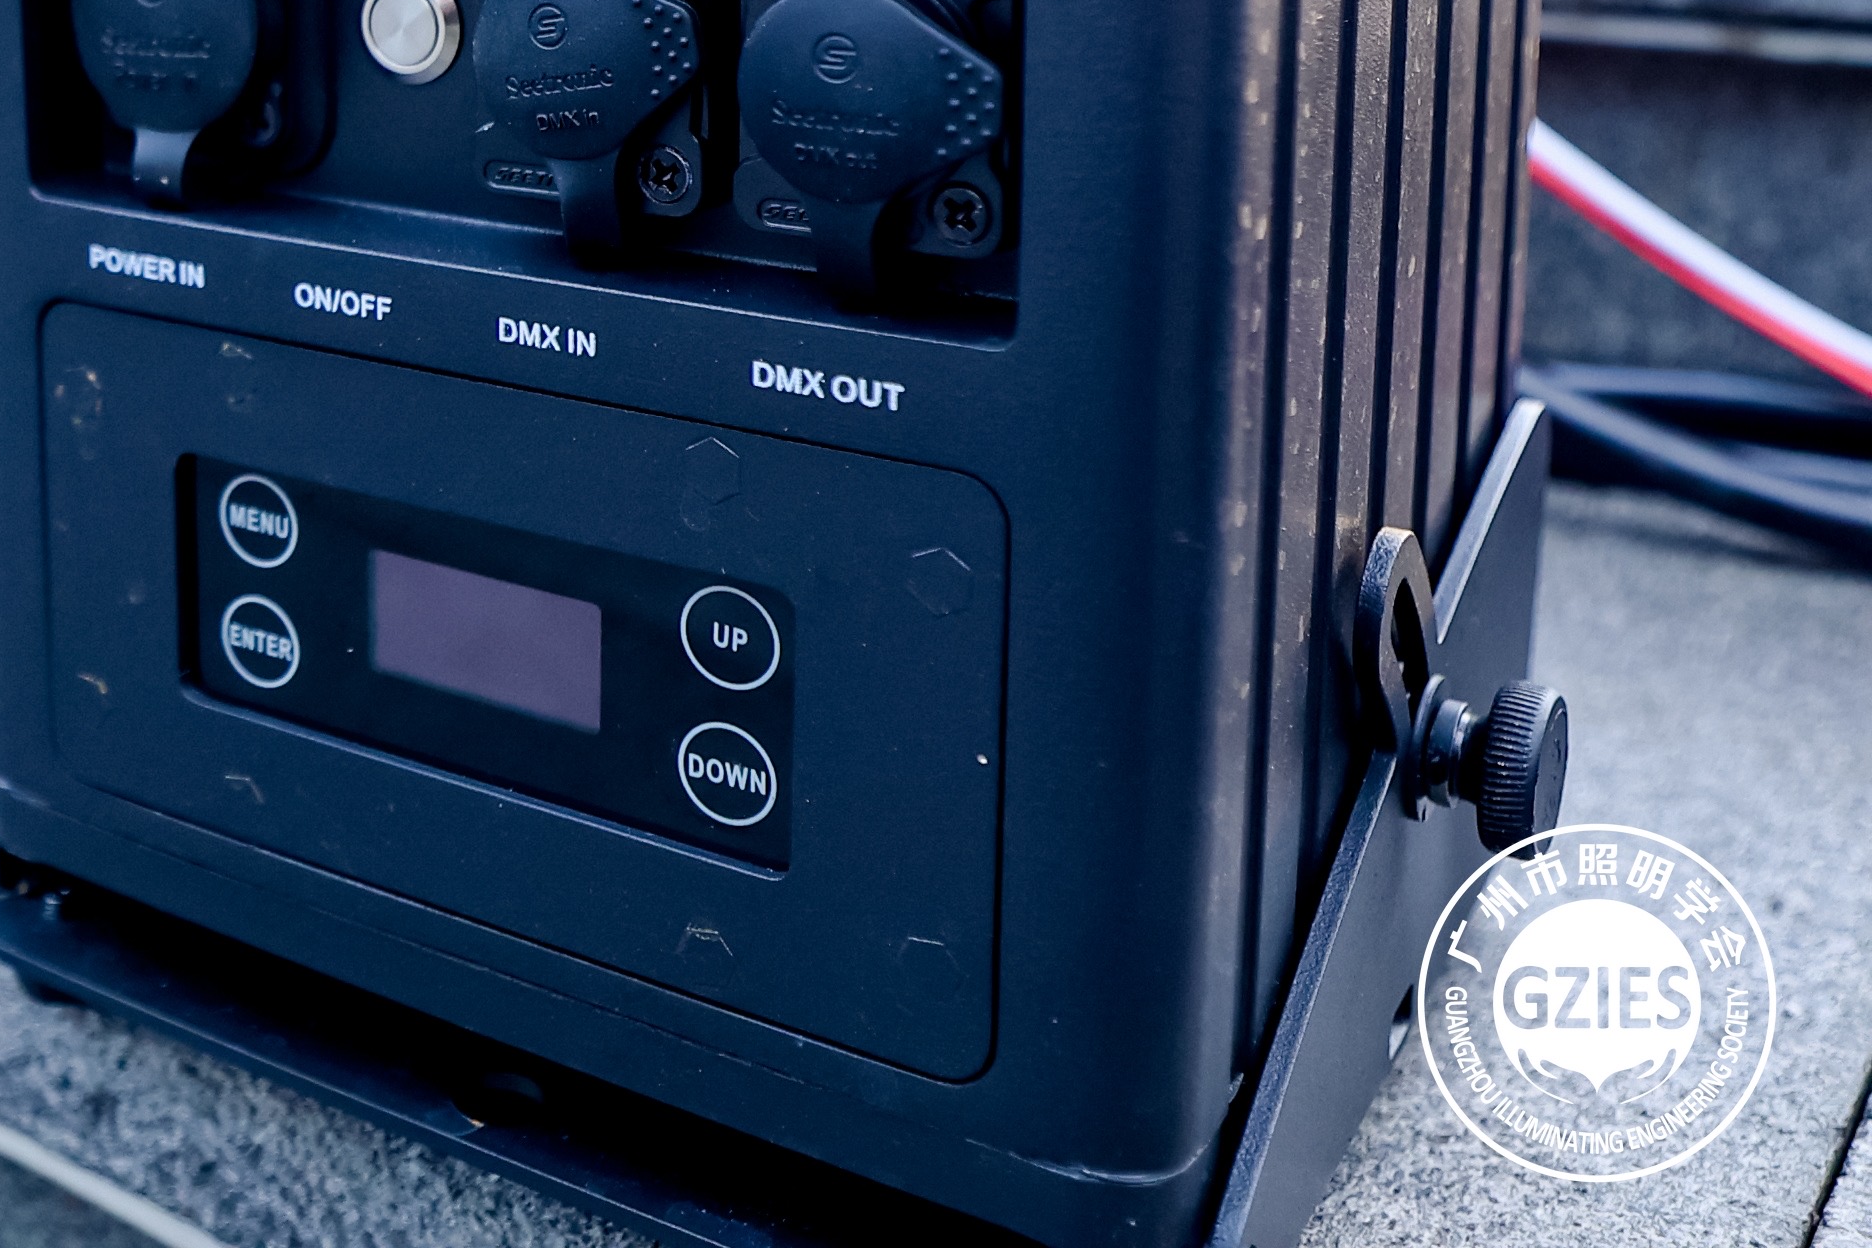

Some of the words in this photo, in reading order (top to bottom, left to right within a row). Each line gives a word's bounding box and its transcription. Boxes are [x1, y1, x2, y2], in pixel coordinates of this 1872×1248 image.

[535, 109, 581, 132] DMX
[583, 107, 600, 127] in
[88, 243, 175, 284] POWER
[178, 258, 206, 290] IN
[294, 281, 393, 322] ON/OFF
[497, 316, 561, 354] DMX
[566, 326, 598, 358] IN
[751, 359, 824, 401] DMX
[830, 371, 906, 413] OUT
[229, 502, 291, 540] MENU
[229, 623, 294, 662] ENTER
[713, 621, 749, 653] UP
[688, 752, 767, 796] DOWN
